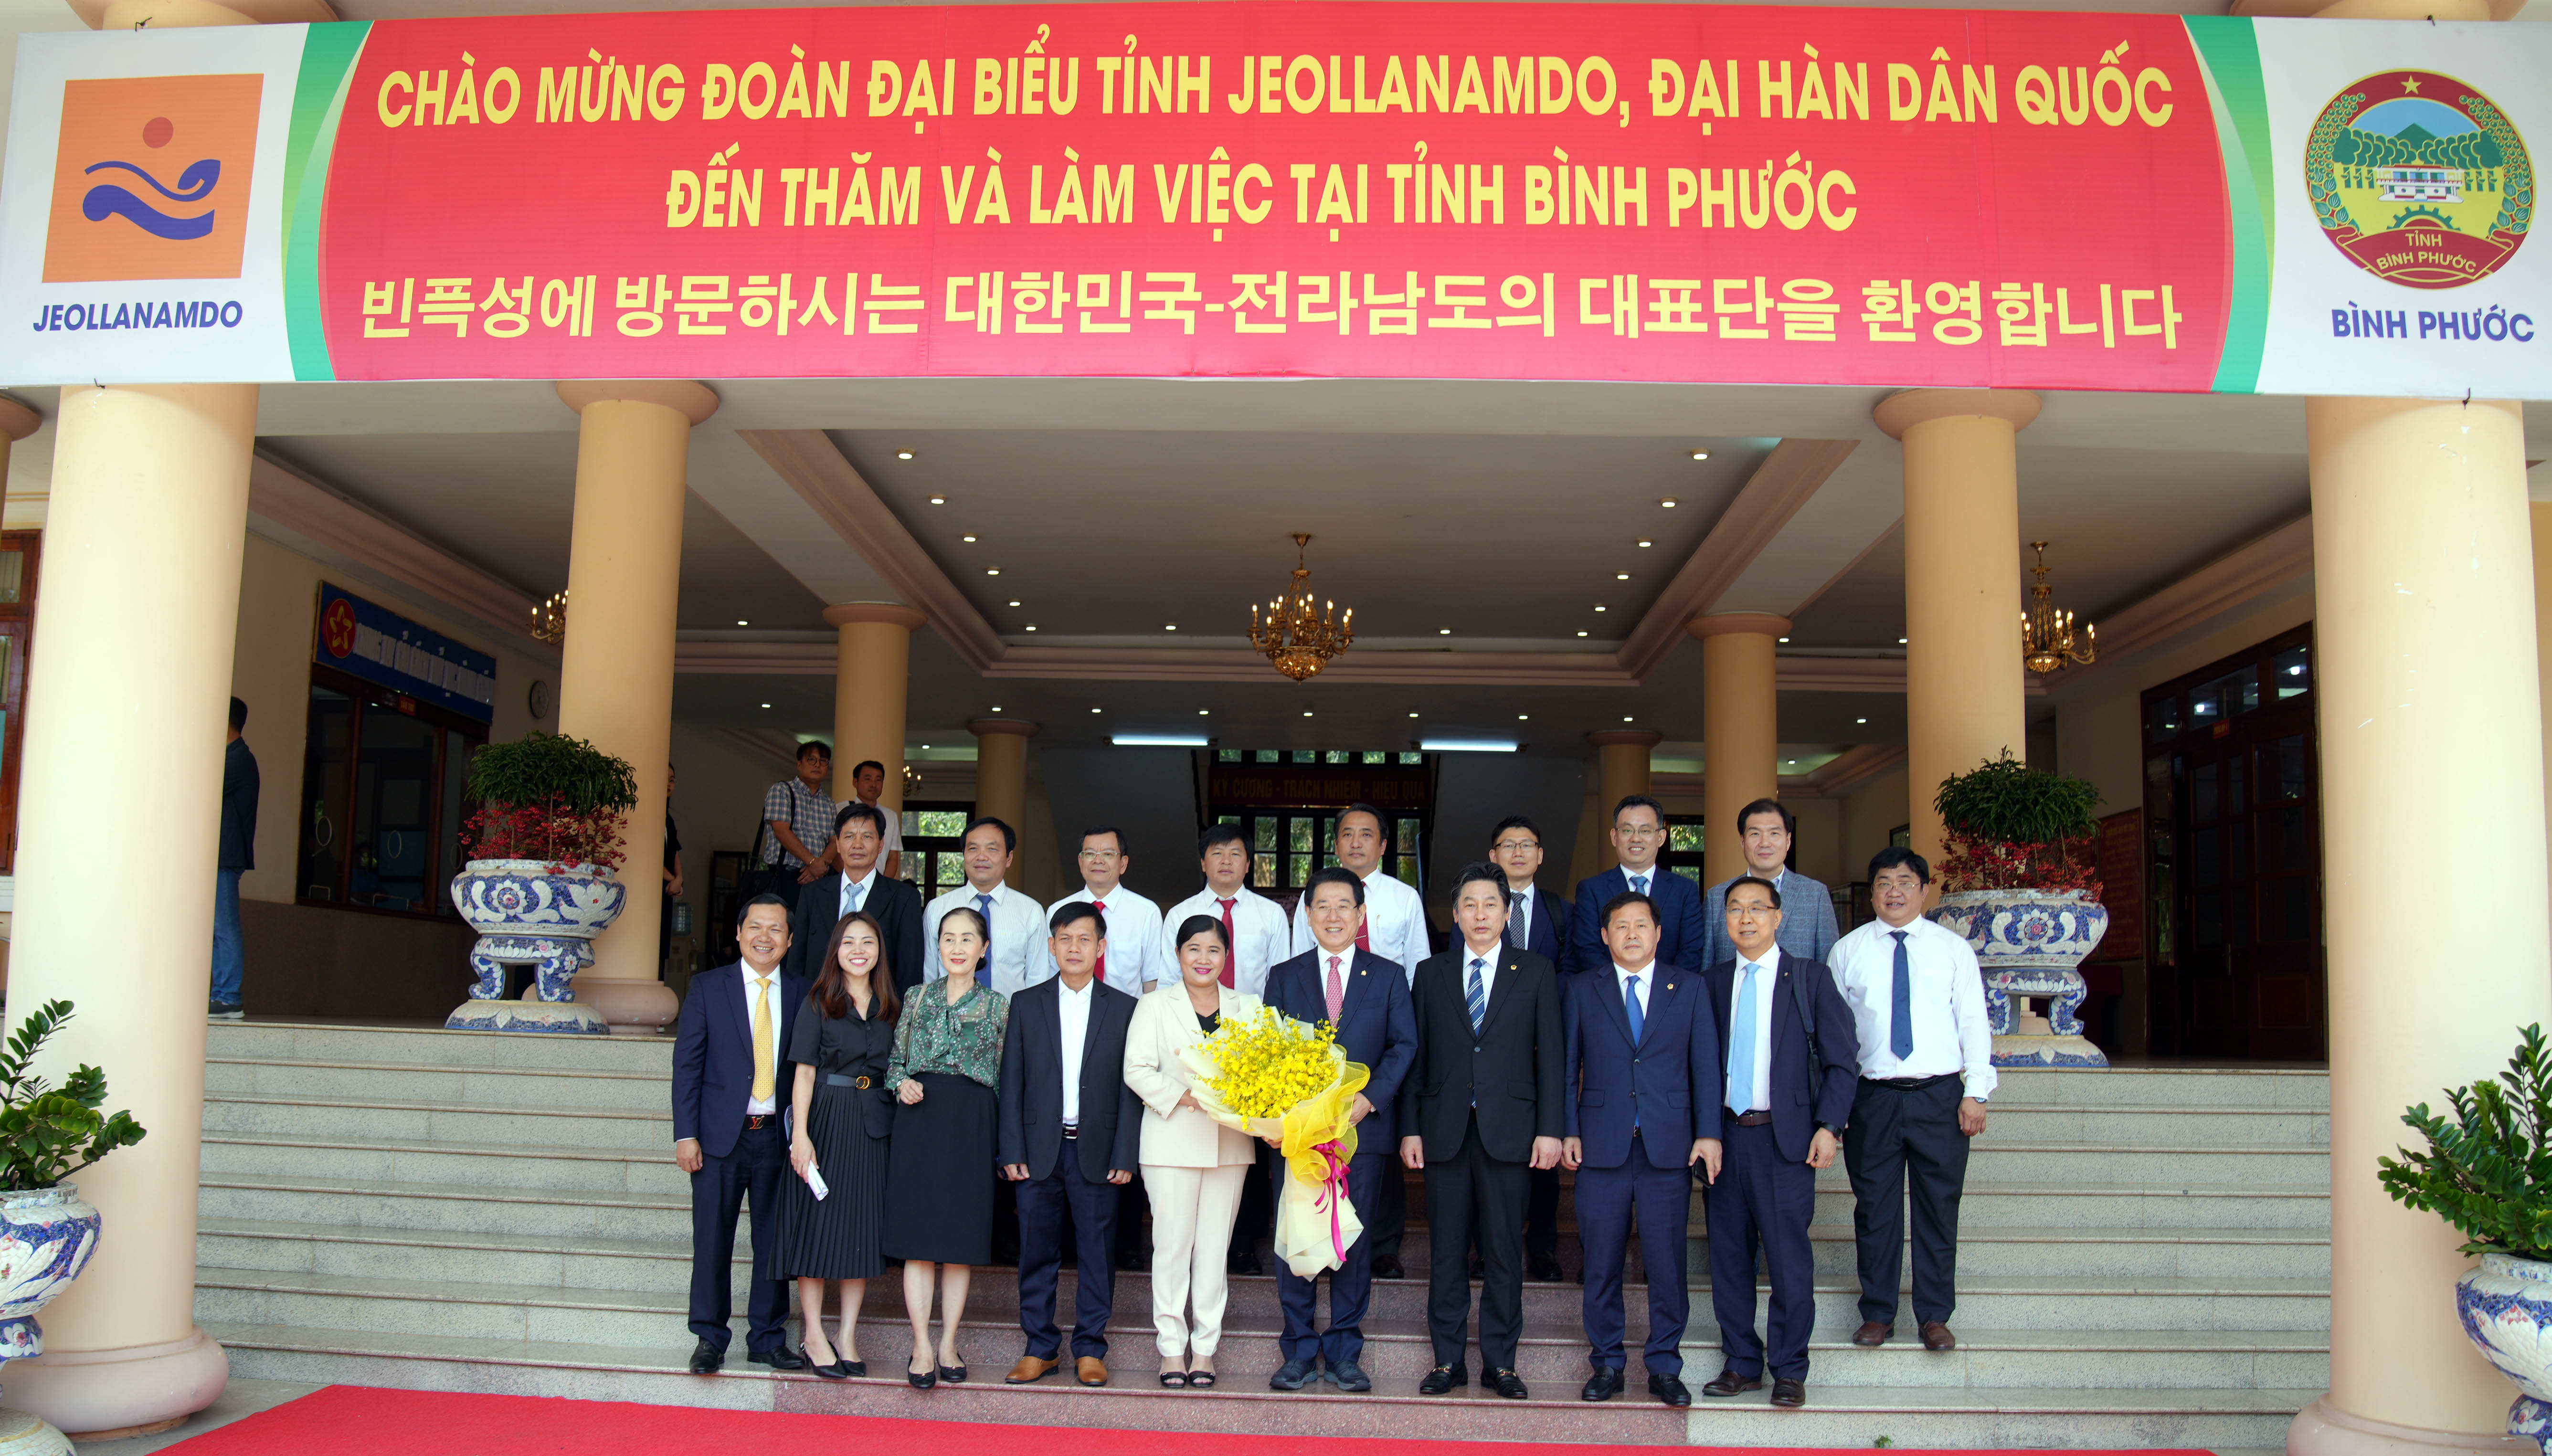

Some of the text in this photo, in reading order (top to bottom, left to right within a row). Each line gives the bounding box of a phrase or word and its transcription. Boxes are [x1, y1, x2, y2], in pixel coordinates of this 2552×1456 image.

[378, 24, 2172, 135] CHÀO MỪNG ĐOÀN ĐẠI BIỂU TỈNH JEOLLANAMDO, ĐẠI HÀN DÂN QUỐC
[666, 141, 1857, 242] ĐẾN THĂM VÀ LÀM VIỆC TẠI TỈNH BÌNH PHƯỚC
[2405, 230, 2442, 247] TỈNH
[2376, 251, 2477, 273] BÌNH PHƯỚC
[33, 301, 244, 332] JEOLLANAMDO
[616, 273, 925, 337] 방문하시는
[945, 271, 1554, 337] 대한민국-전라남도의
[1579, 274, 1840, 341] 대표단을
[1861, 279, 2182, 348] 환영합니다
[2331, 301, 2534, 342] BÌNH PHƯỚC
[1283, 775, 1321, 799] TRÁCH
